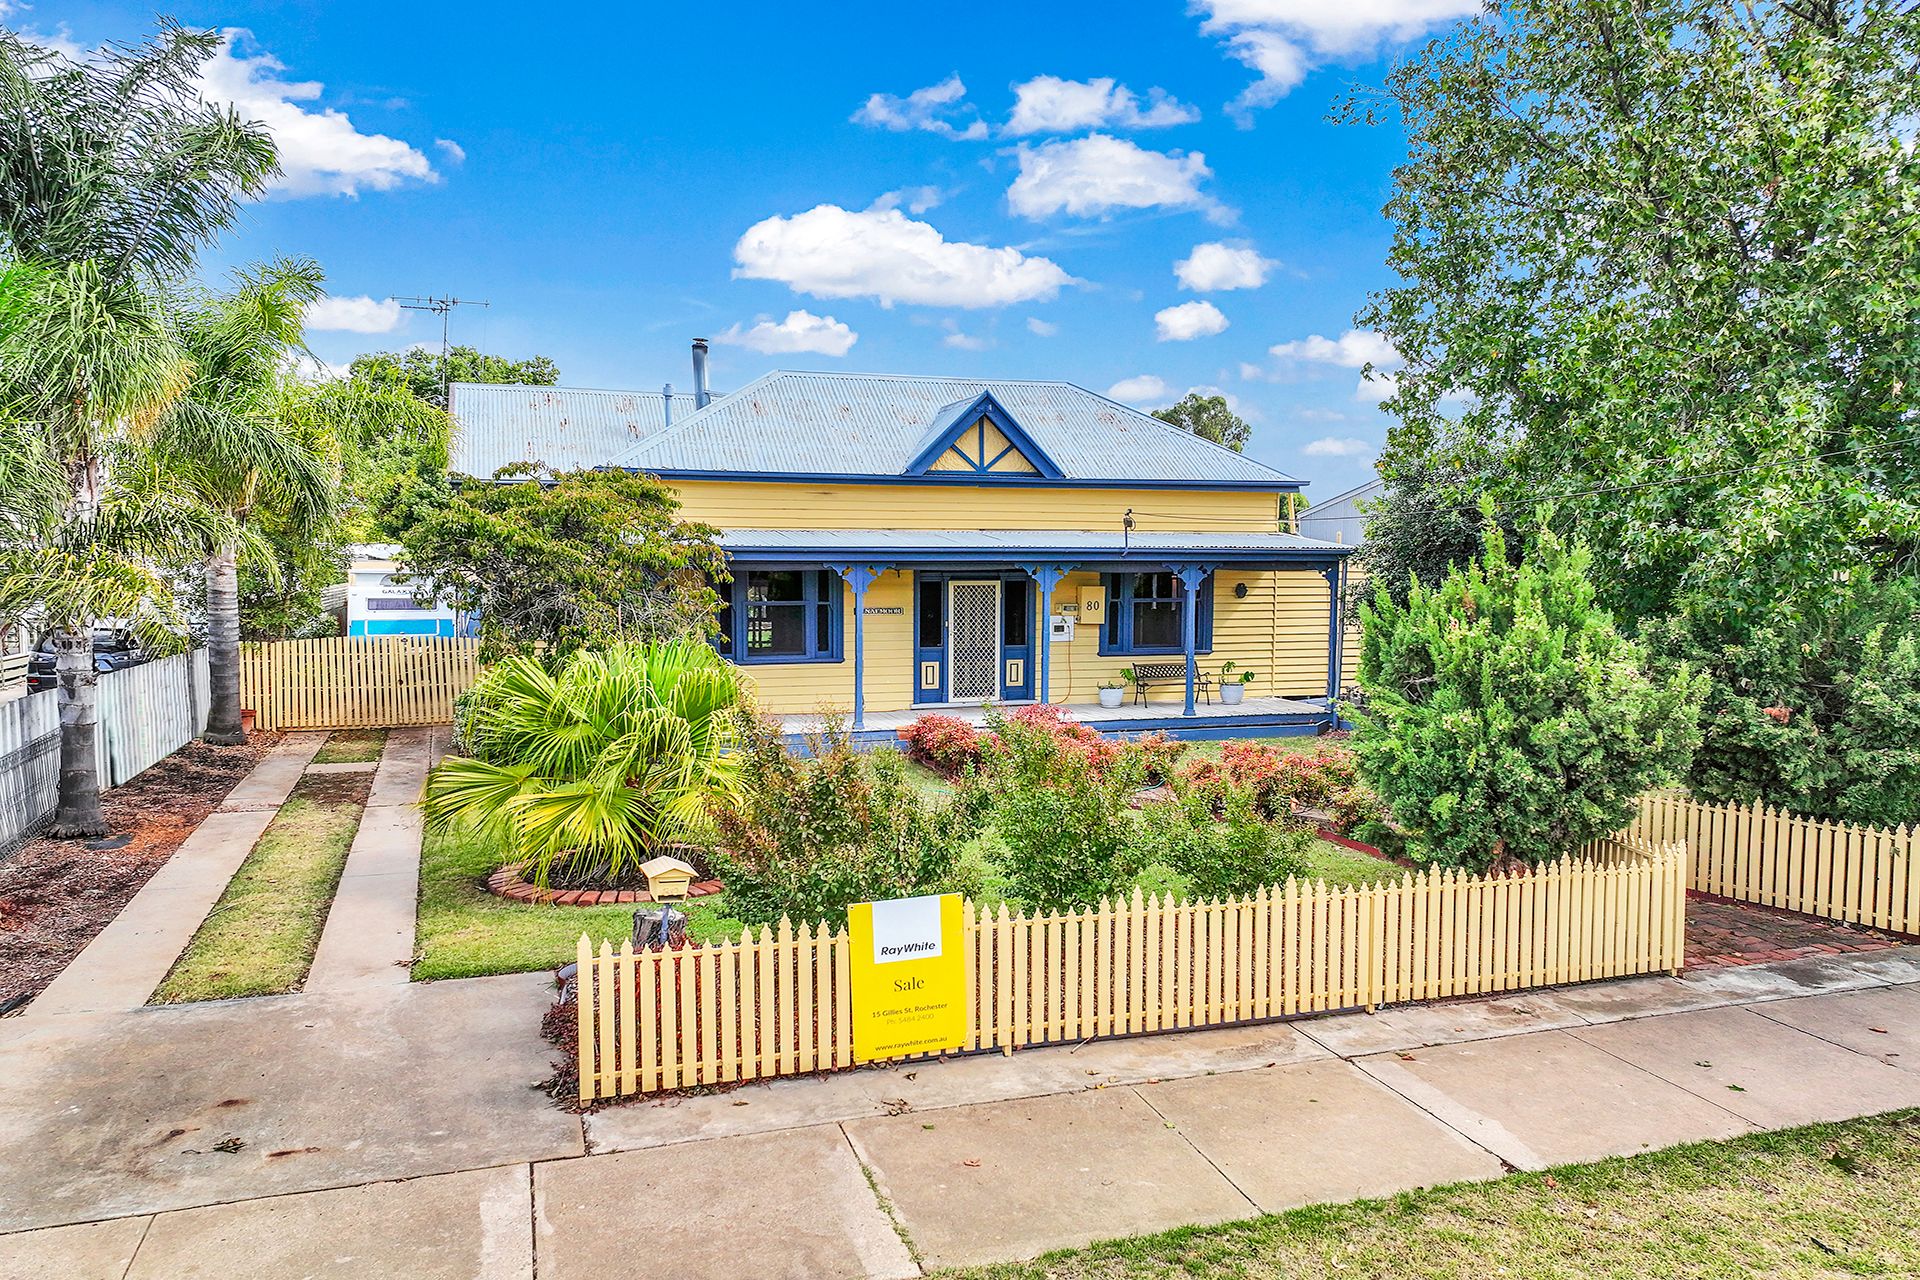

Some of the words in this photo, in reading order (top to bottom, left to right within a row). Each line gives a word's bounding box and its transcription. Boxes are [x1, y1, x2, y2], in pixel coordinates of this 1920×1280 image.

[1086, 600, 1099, 611] 80
[894, 977, 925, 992] Sale
[914, 1003, 948, 1013] Rochester
[875, 1036, 948, 1051] www.raywhite.com.au
